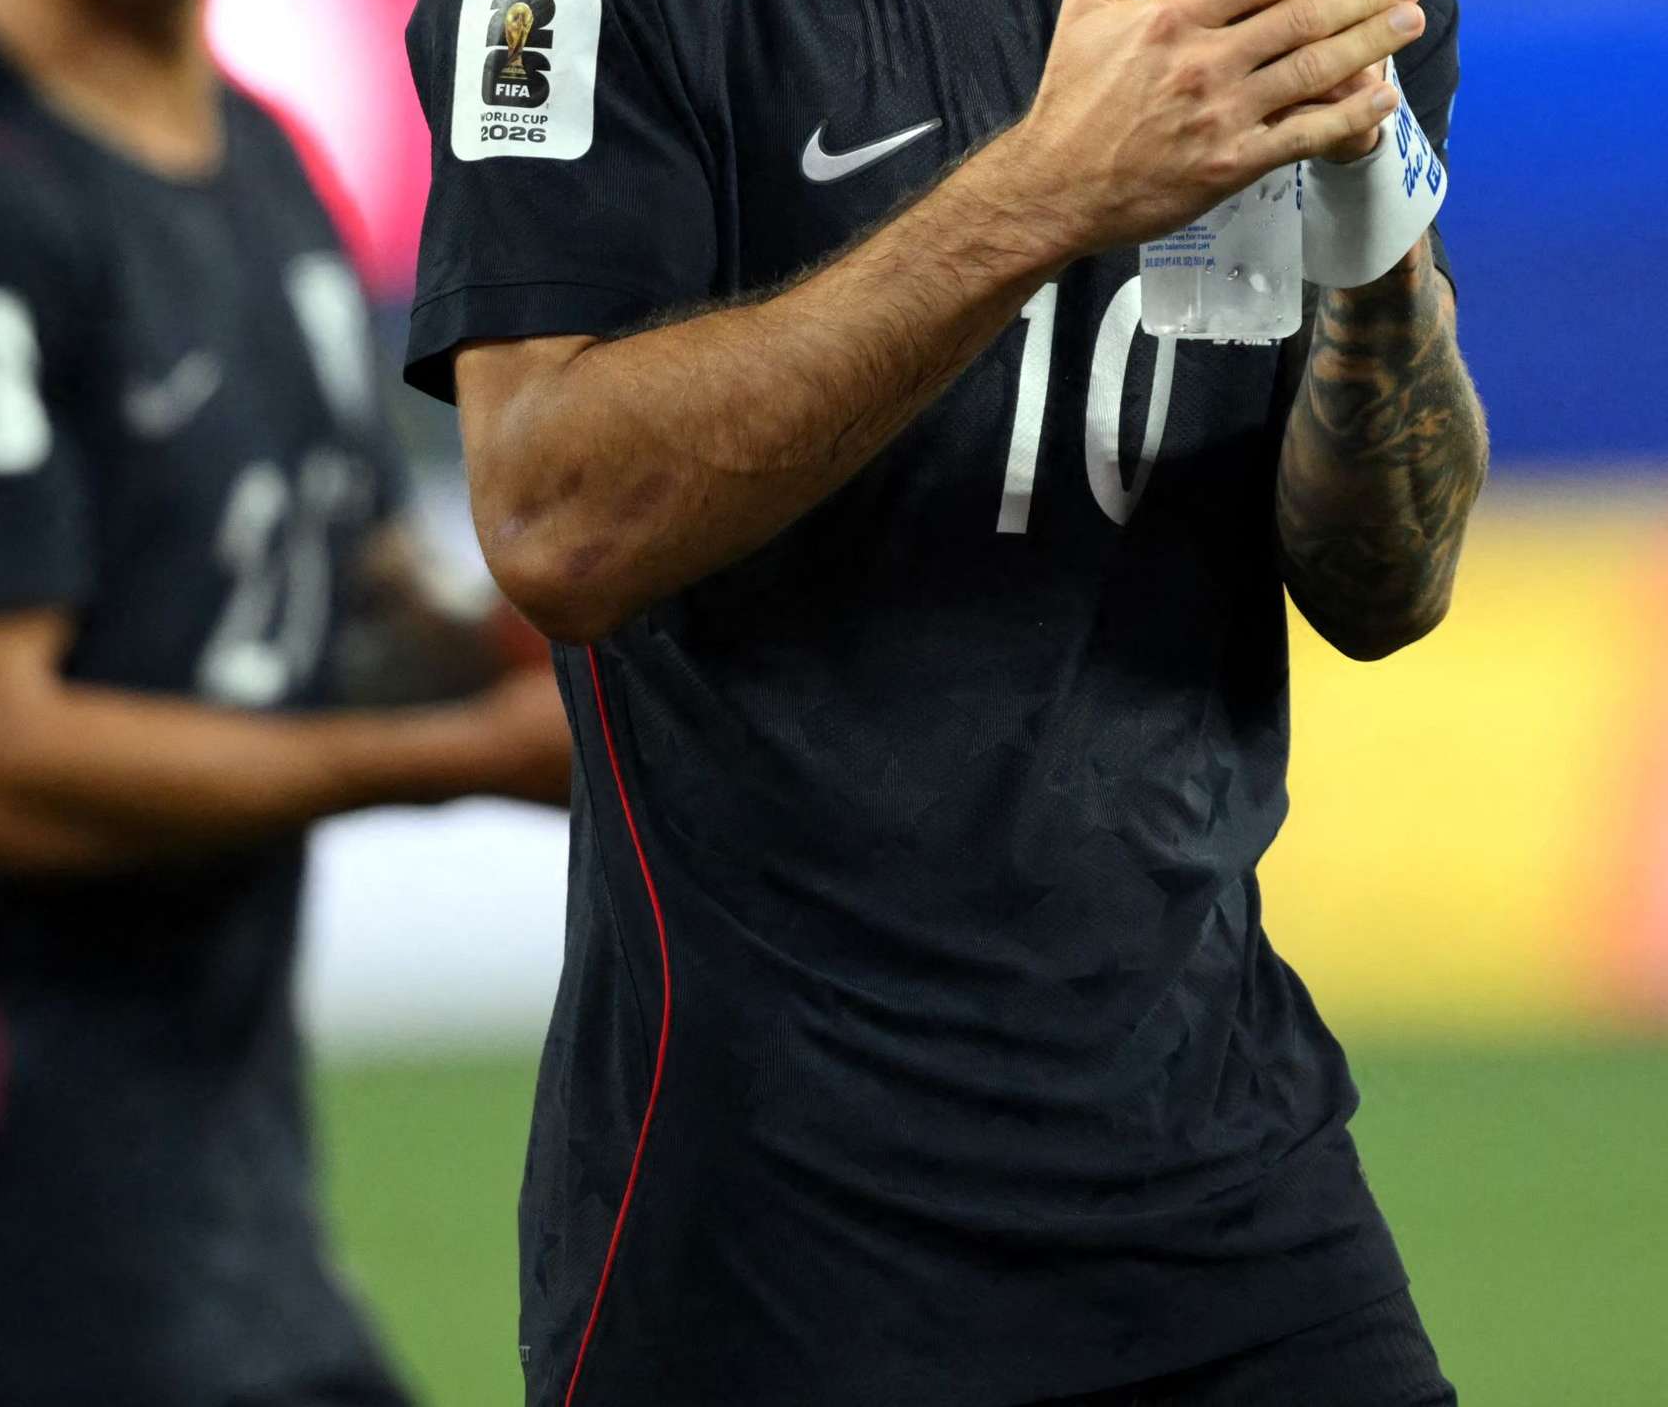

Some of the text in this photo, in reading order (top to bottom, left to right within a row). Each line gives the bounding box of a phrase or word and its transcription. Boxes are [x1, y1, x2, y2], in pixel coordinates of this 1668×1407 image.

[495, 83, 531, 98] FIFA
[522, 114, 549, 125] CUP
[481, 124, 547, 143] 2026
[996, 275, 1177, 534] 10
